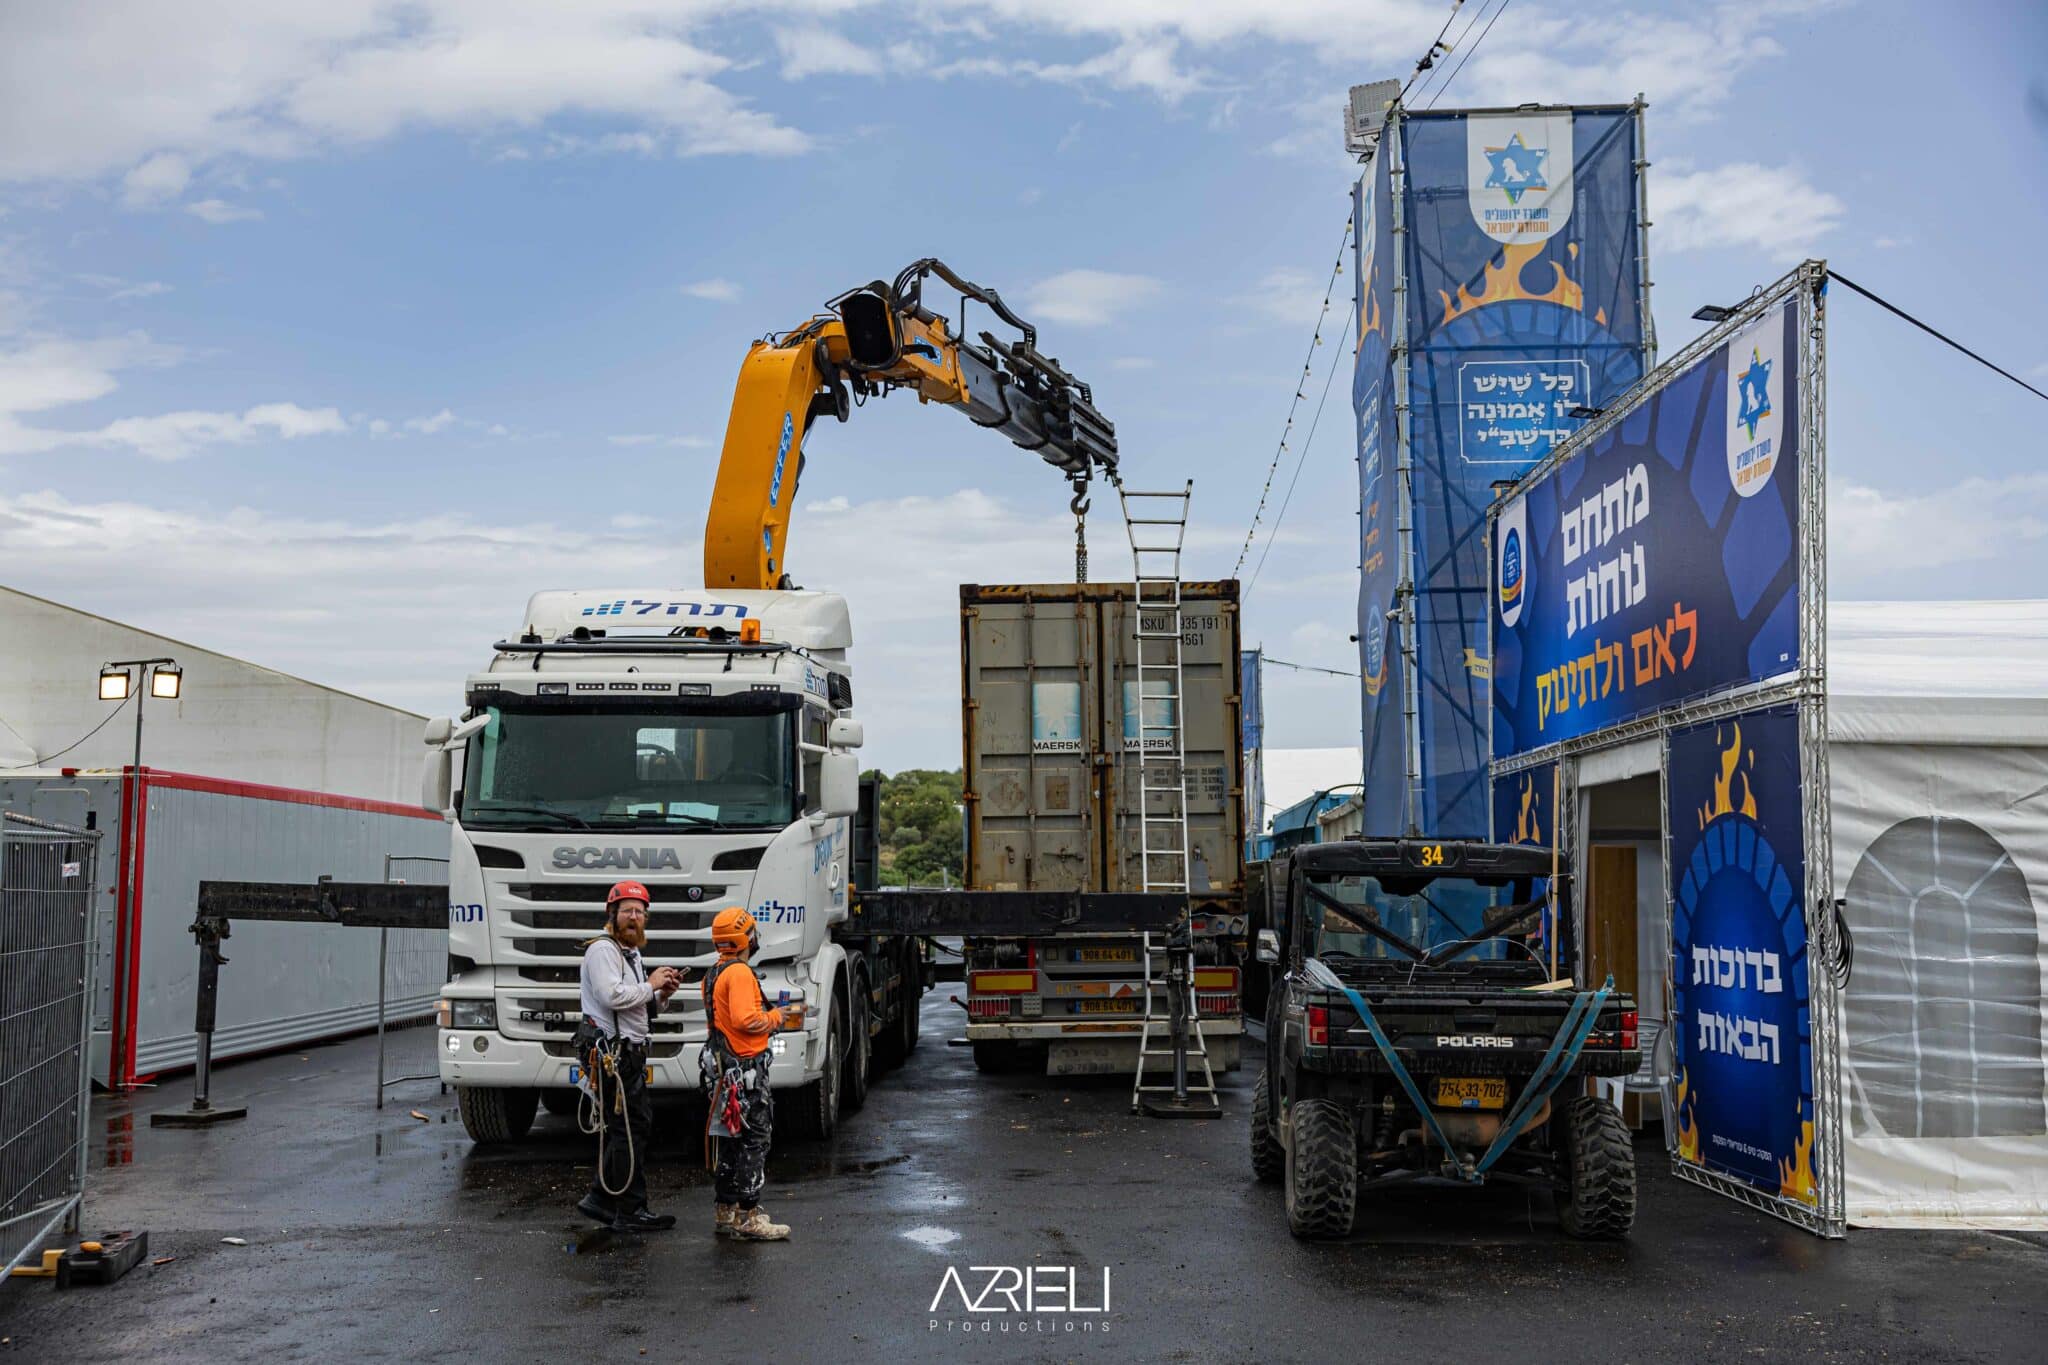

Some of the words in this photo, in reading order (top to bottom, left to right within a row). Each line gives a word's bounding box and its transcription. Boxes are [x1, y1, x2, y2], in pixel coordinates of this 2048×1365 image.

[1561, 463, 1650, 567] מתחם
[1566, 540, 1647, 639] נוחות
[630, 600, 749, 618] תהל
[1202, 617, 1218, 630] 191
[1631, 602, 1697, 687] לאם
[1536, 638, 1624, 732] ולתינוק
[1033, 741, 1081, 750] MAERSK
[1124, 739, 1173, 748] MAERSK
[552, 846, 682, 870] SCANIA
[1421, 845, 1444, 867] 34
[773, 900, 805, 923] תהל
[1692, 943, 1783, 993] ברוכות
[522, 1011, 532, 1020] R
[533, 1011, 563, 1022] 450
[1436, 1036, 1514, 1048] POLARIS
[1698, 1008, 1780, 1065] הבאות
